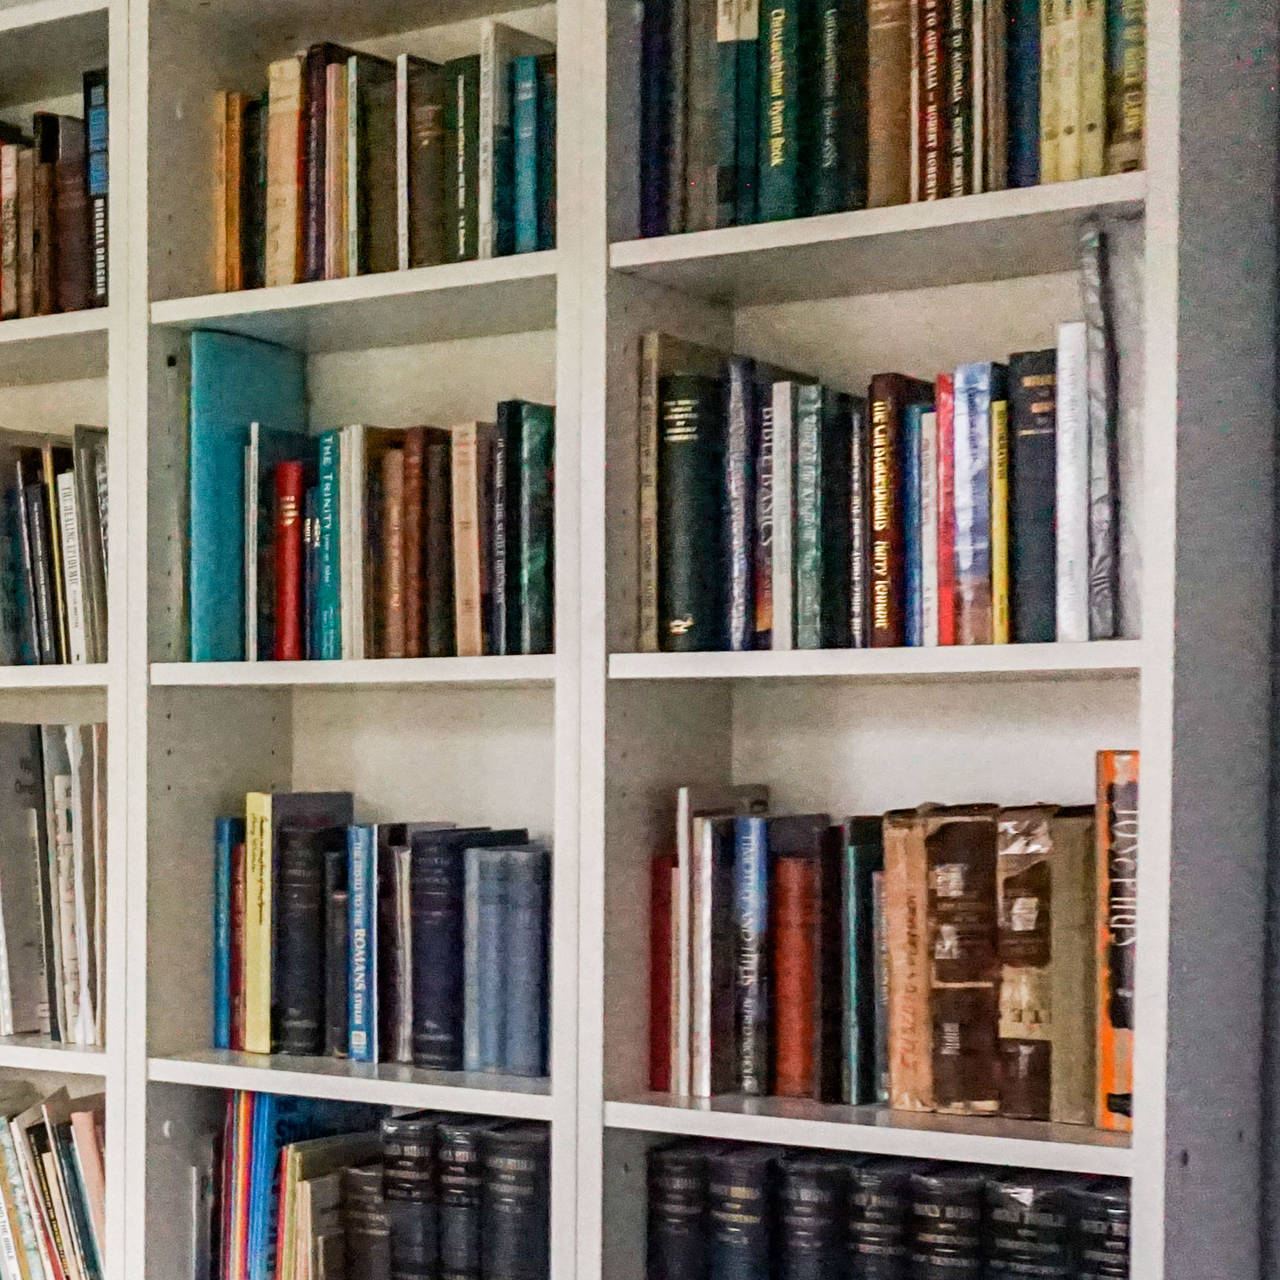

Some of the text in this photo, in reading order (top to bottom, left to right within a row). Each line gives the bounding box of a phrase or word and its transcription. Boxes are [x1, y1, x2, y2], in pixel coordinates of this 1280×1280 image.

[925, 30, 938, 89] AUSTRALIA
[951, 51, 963, 102] AUSTRALIA
[770, 137, 785, 167] Book
[925, 105, 938, 149] ROBERT
[95, 199, 105, 244] MICHAEL
[323, 435, 333, 529] THE TRINITY
[761, 473, 774, 547] BASICS
[874, 540, 889, 575] Harry
[354, 928, 366, 990] ROMANS
